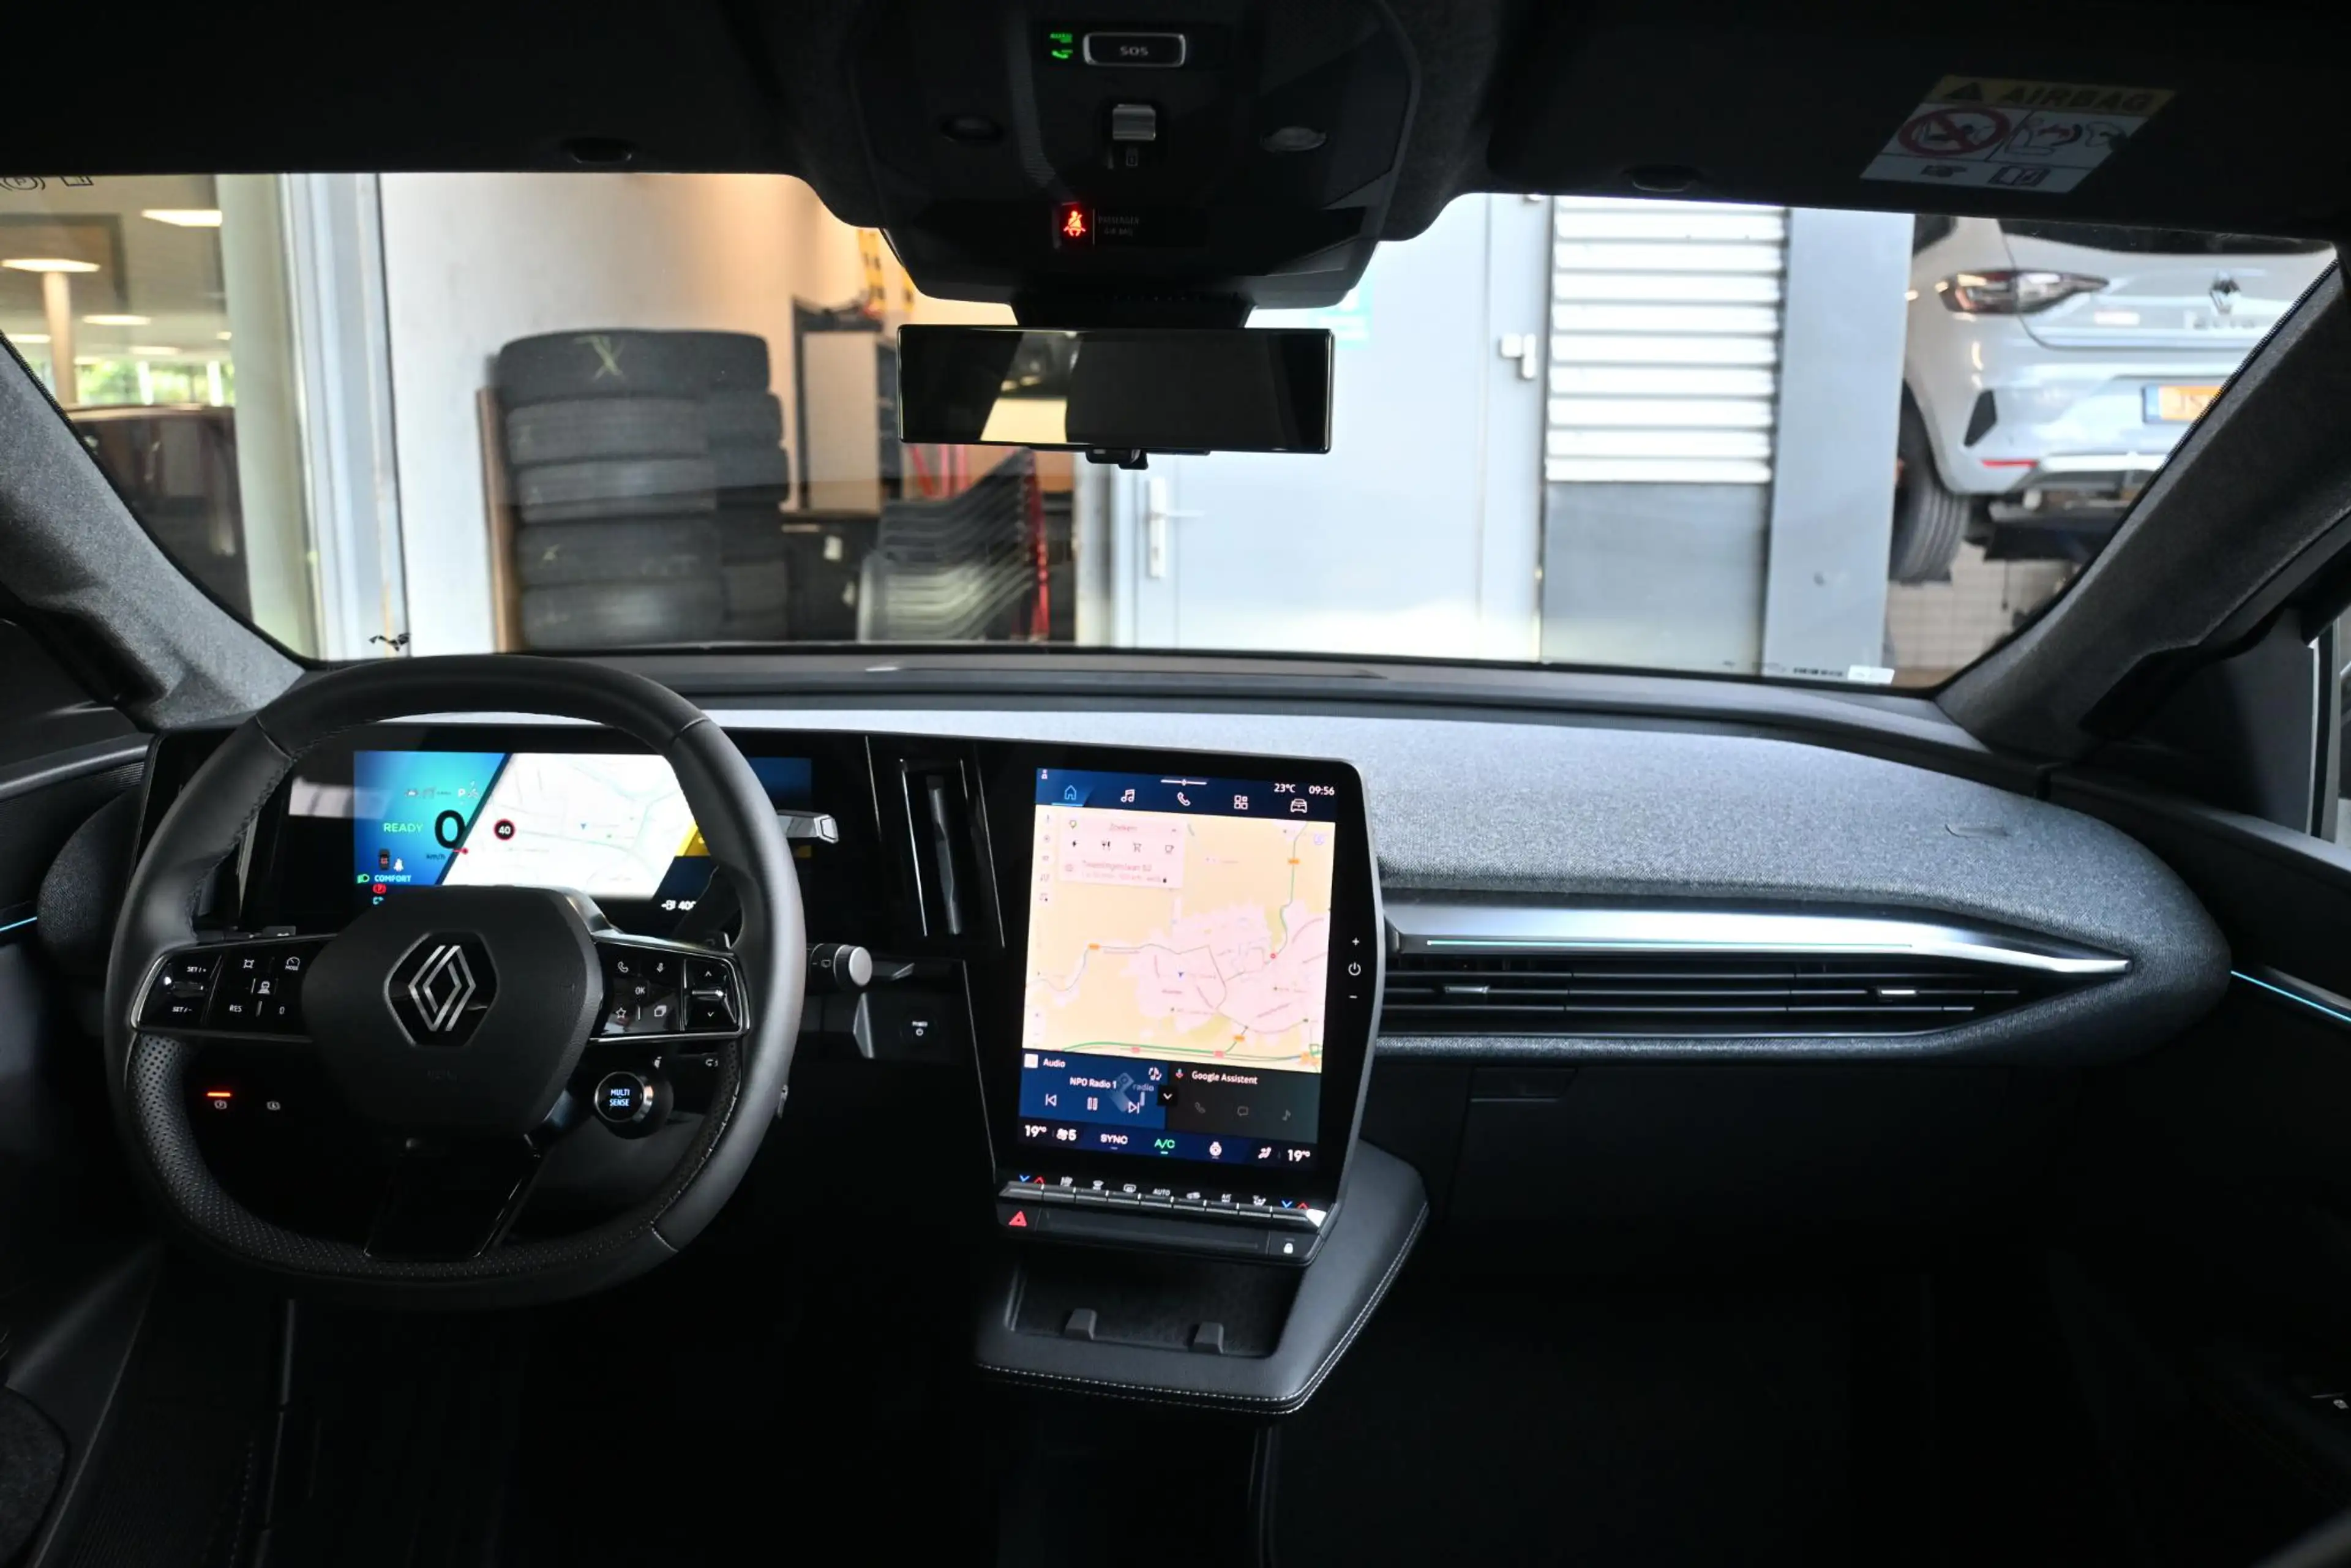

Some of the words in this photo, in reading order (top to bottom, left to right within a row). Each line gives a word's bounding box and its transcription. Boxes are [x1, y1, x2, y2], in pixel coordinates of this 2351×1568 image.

[1120, 46, 1149, 56] SOS
[2000, 84, 2156, 113] AIRBAG
[1308, 785, 1335, 796] 09:56
[383, 822, 424, 833] READY
[434, 809, 466, 849] 0
[498, 825, 511, 835] 40
[426, 853, 446, 861] km/h
[635, 987, 645, 996] OK
[1043, 1058, 1066, 1068] Audio
[1070, 1077, 1088, 1087] NPO
[1089, 1078, 1111, 1089] Radio
[1112, 1081, 1117, 1089] 1
[1191, 1070, 1220, 1082] Google
[1221, 1073, 1258, 1085] Assistent
[1132, 1083, 1155, 1092] radio
[1068, 1128, 1077, 1141] 5
[1100, 1133, 1128, 1145] SYNC
[1153, 1138, 1176, 1149] A/C
[1152, 1188, 1171, 1196] AUTO
